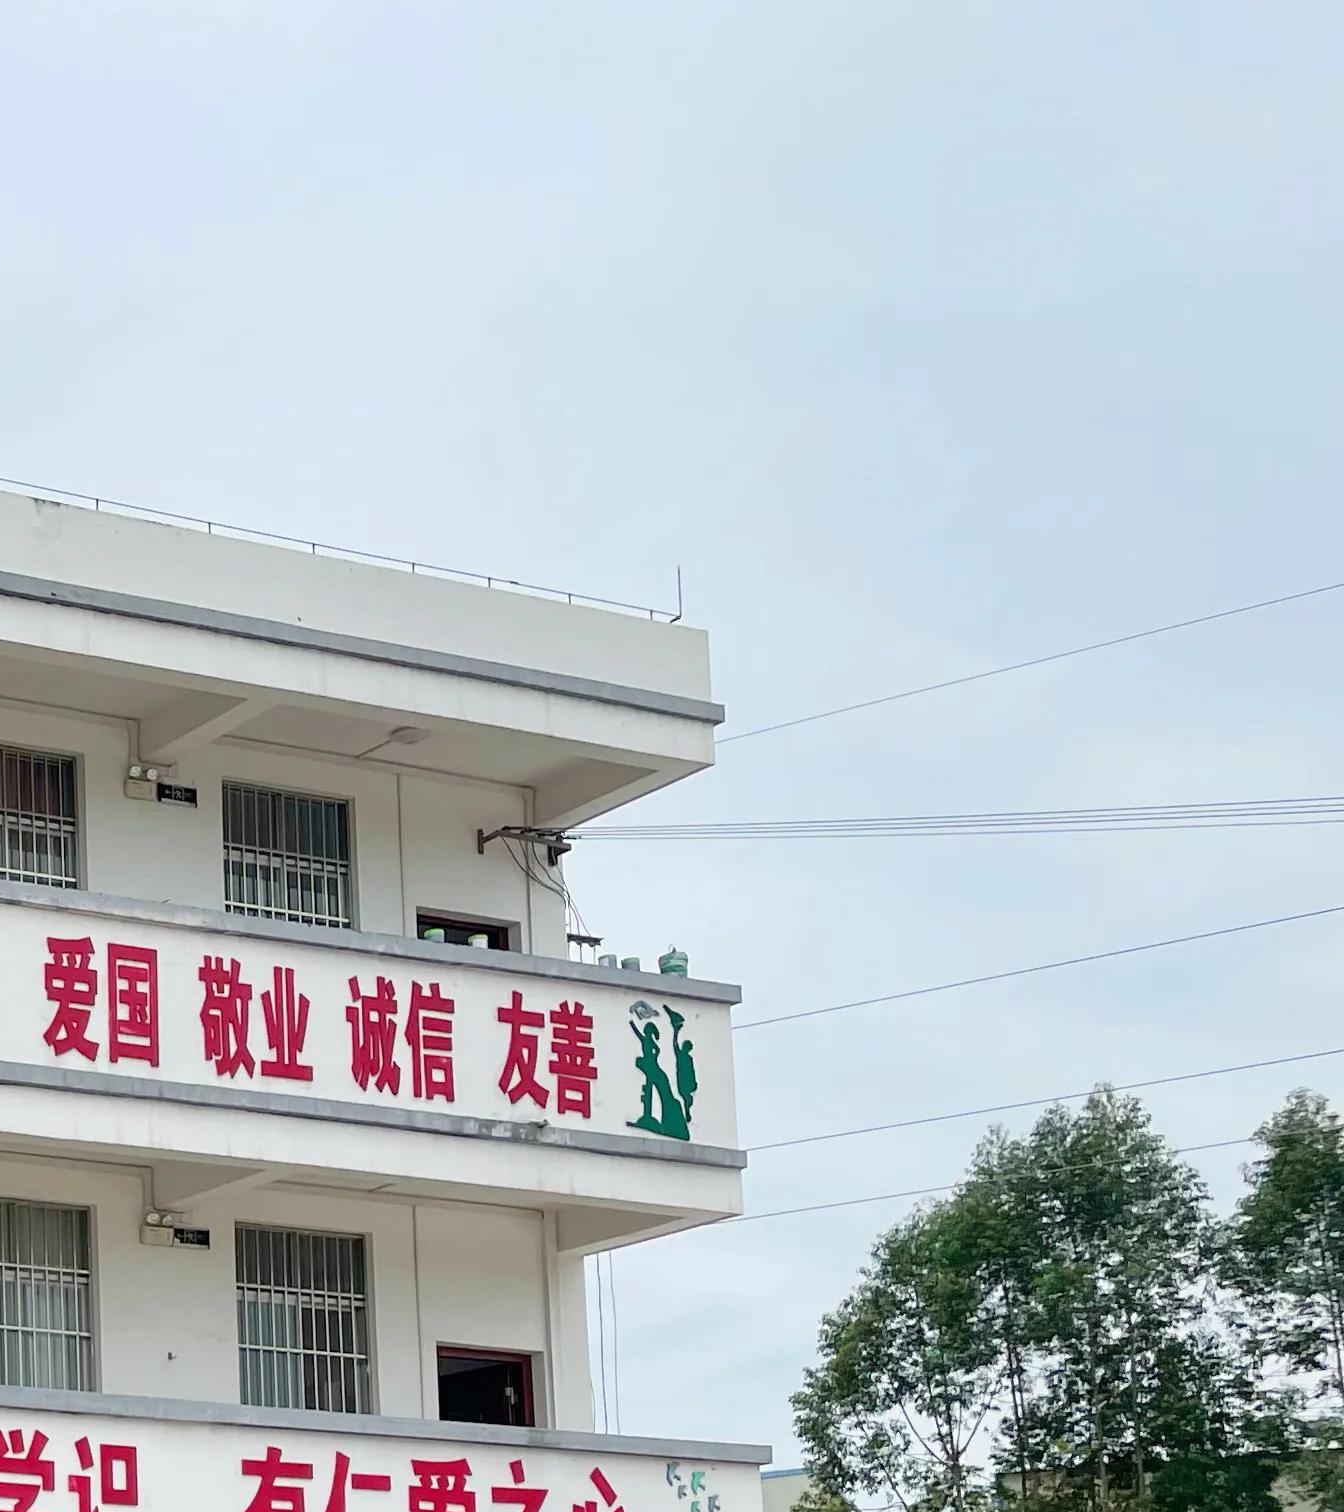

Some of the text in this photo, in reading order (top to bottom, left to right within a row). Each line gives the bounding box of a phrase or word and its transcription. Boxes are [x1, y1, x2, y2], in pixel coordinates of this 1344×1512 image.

[43, 937, 159, 1067] 爱国
[199, 956, 312, 1081] 敬业
[346, 976, 454, 1102] 诚信
[497, 992, 598, 1118] 友善
